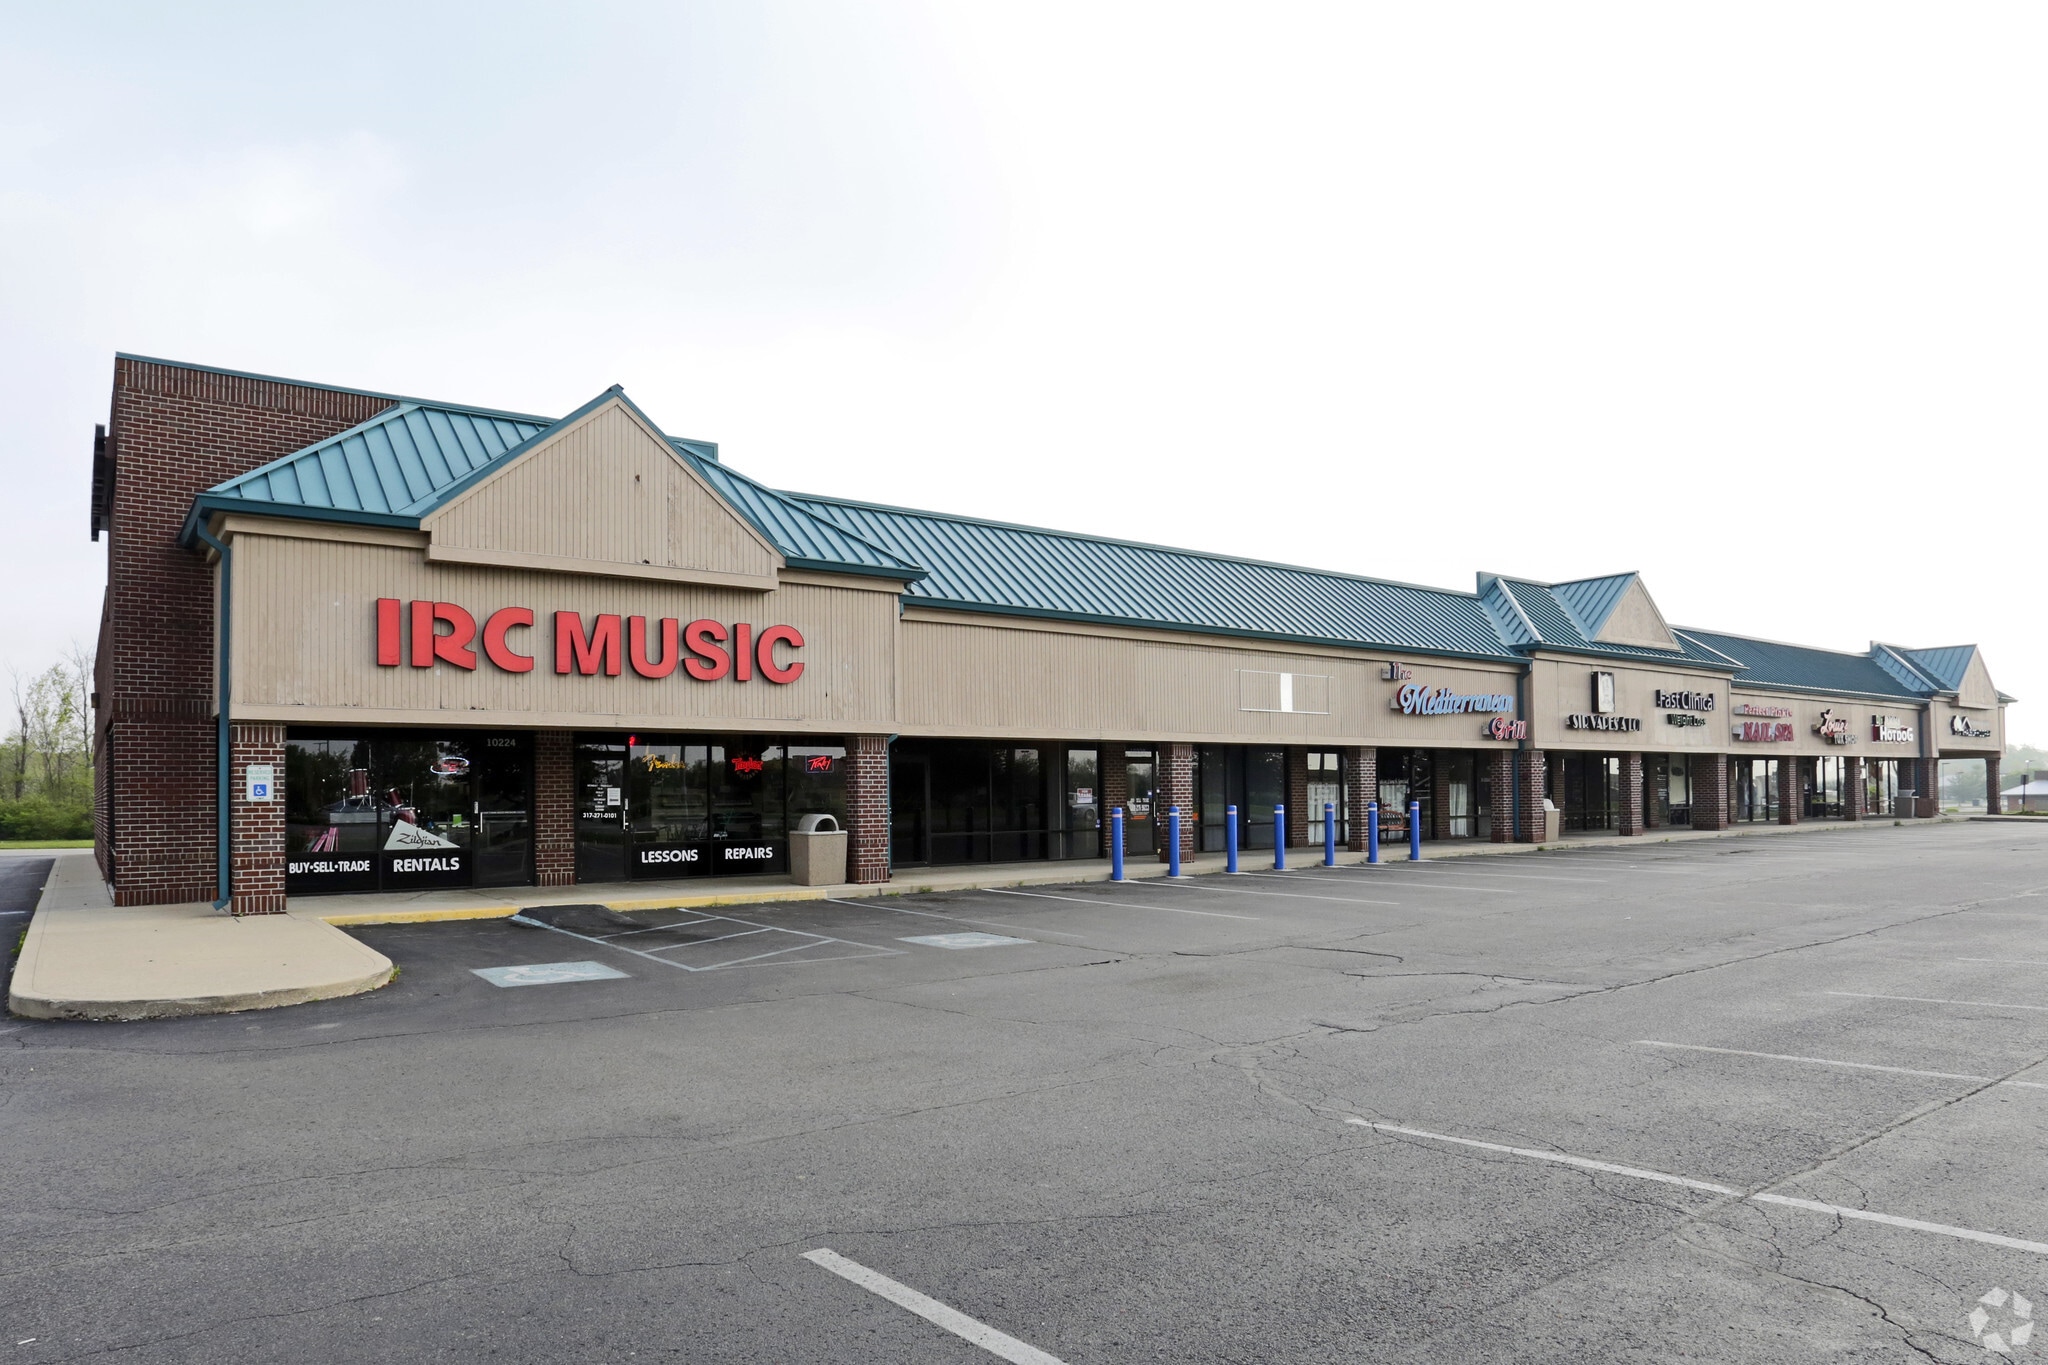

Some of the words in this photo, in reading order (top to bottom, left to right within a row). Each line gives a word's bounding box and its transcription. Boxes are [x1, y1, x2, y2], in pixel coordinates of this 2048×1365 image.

[376, 597, 535, 674] IRC
[554, 610, 806, 685] MUSIC
[1391, 661, 1412, 680] The
[1398, 683, 1514, 715] Mediterranean
[1660, 690, 1680, 709] Fast
[1490, 717, 1528, 741] Grill
[1573, 714, 1589, 730] SIR
[1743, 722, 1772, 742] NAIL
[1774, 723, 1795, 742] SPA
[486, 738, 516, 747] 10224
[731, 757, 764, 773] Taylor
[396, 829, 441, 849] Zildjian
[641, 849, 699, 863] LESSONS
[724, 846, 774, 860] REPAIRS
[393, 857, 460, 873] RENTALS
